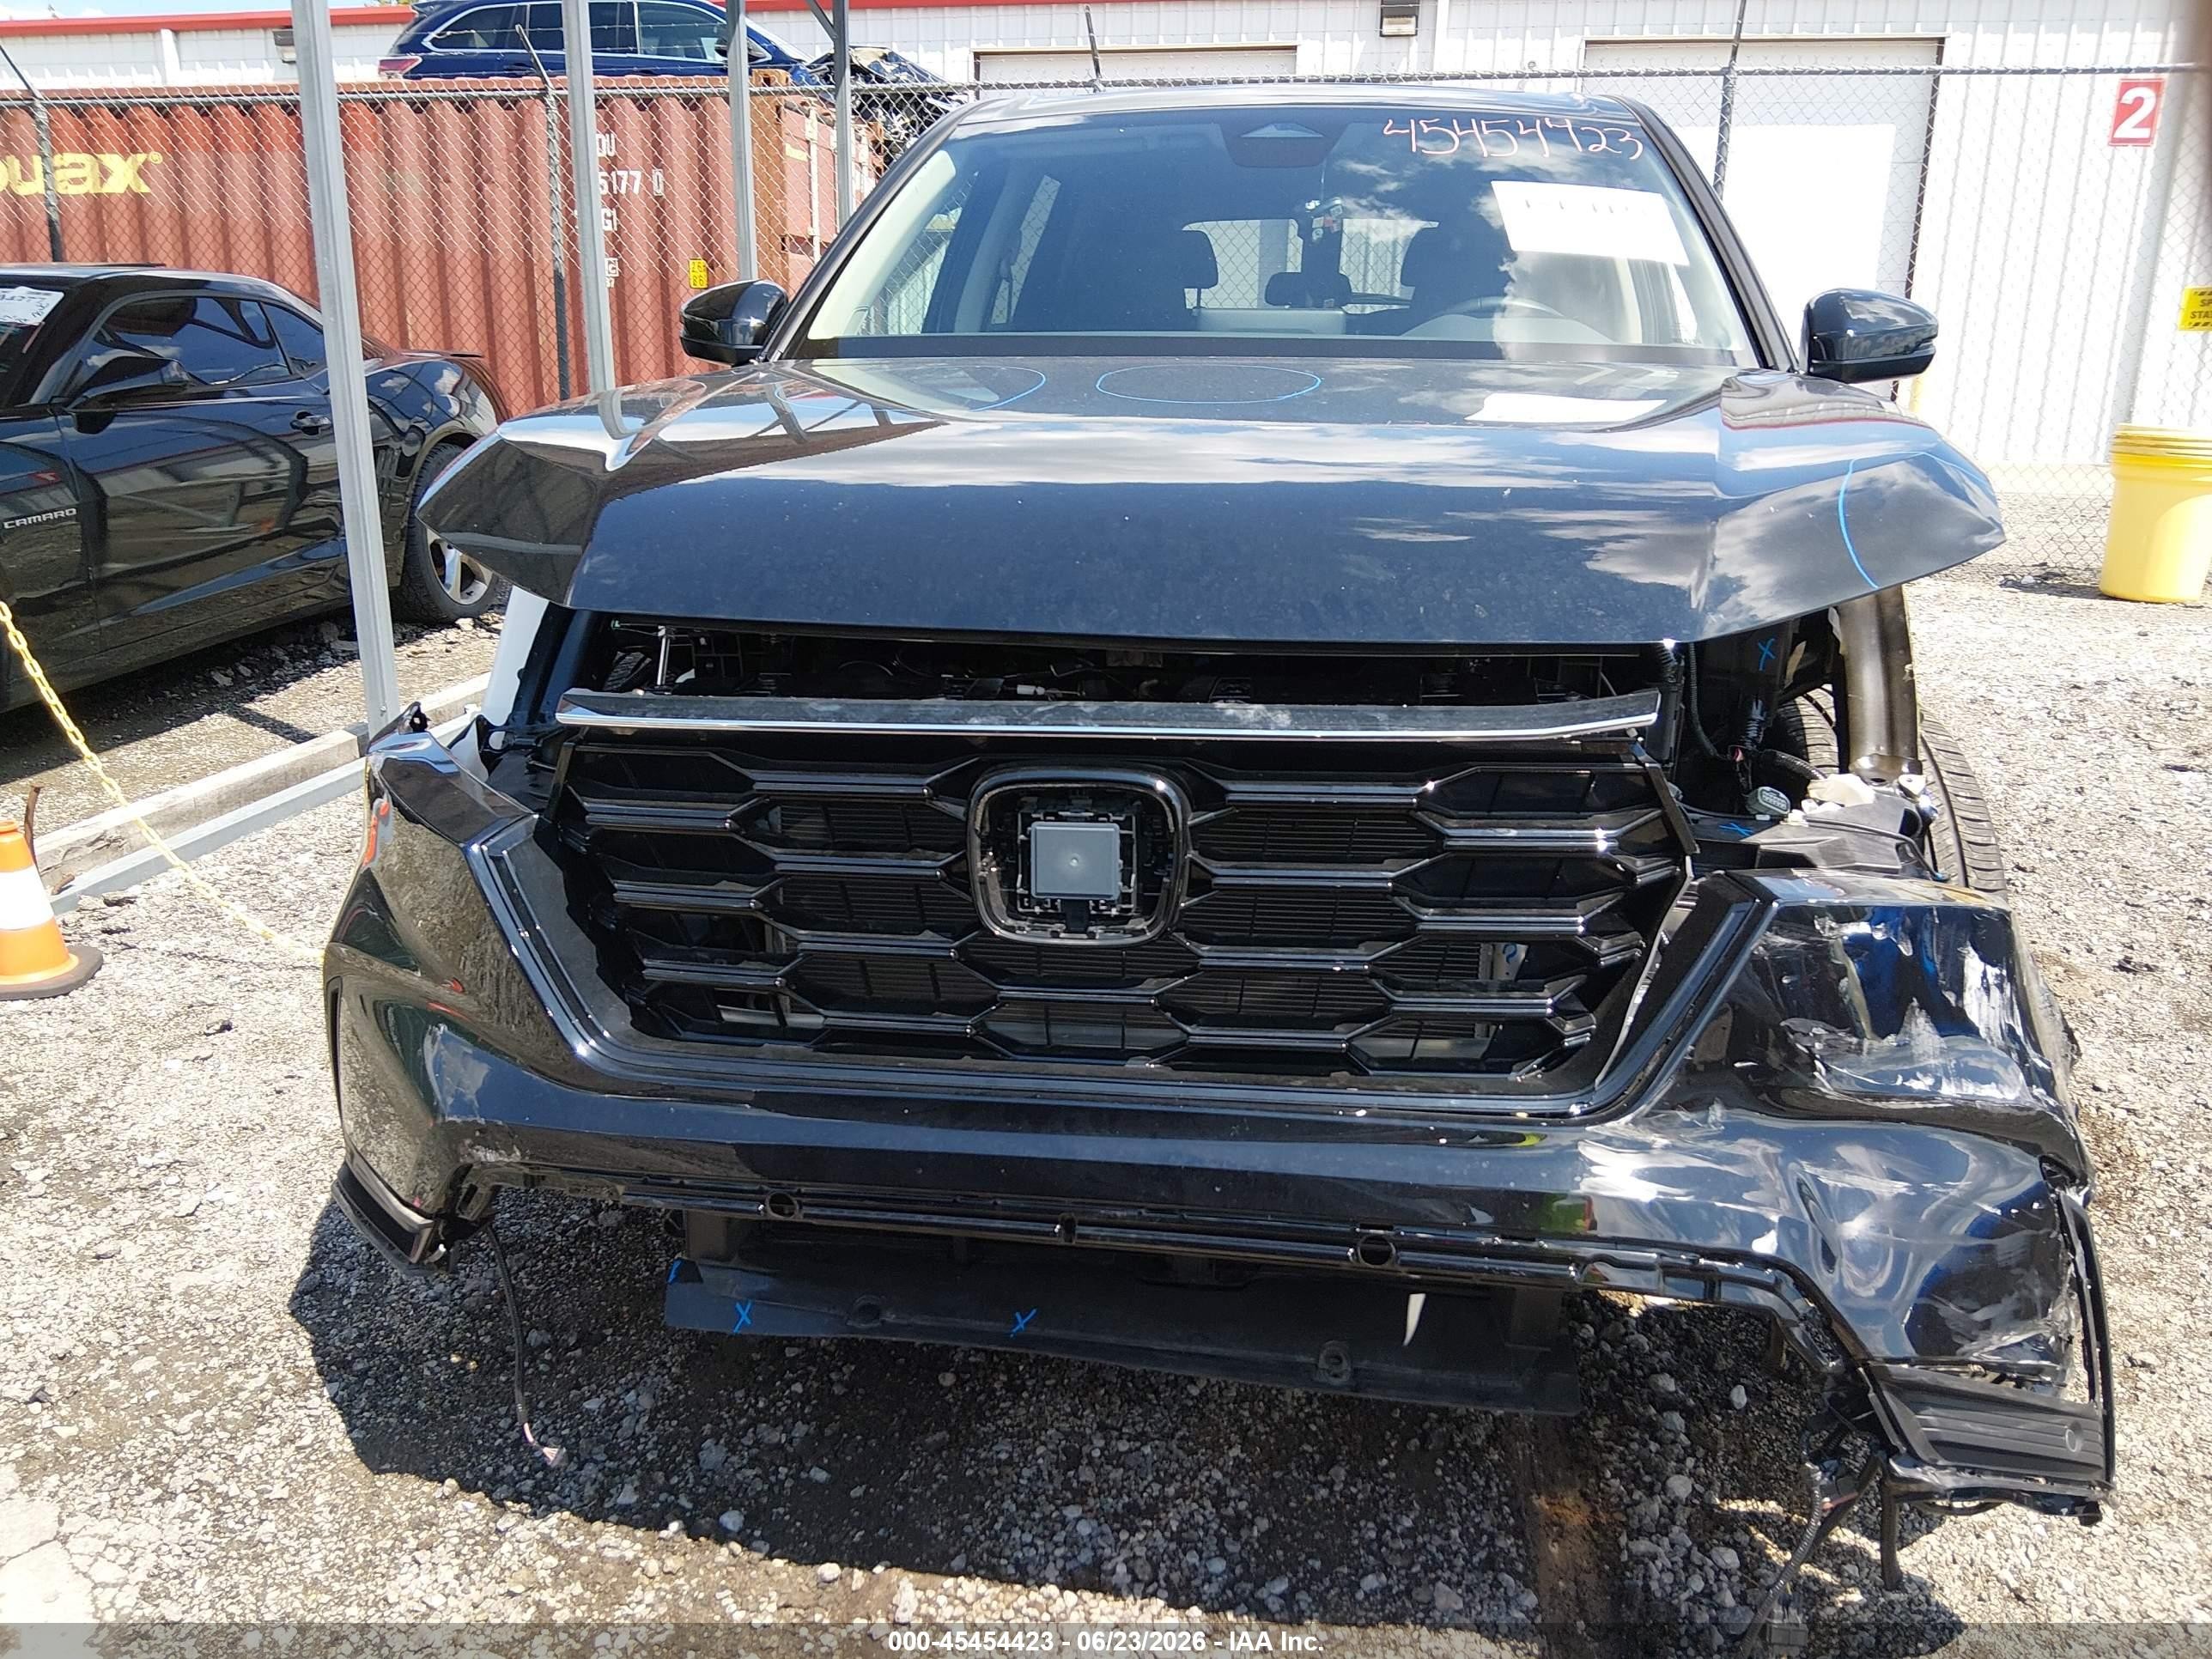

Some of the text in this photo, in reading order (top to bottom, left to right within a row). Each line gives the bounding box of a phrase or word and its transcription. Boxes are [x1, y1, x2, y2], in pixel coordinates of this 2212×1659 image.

[2112, 87, 2156, 138] 2
[596, 133, 616, 157] DU
[599, 170, 641, 196] 5177
[3, 507, 77, 529] CAMARO
